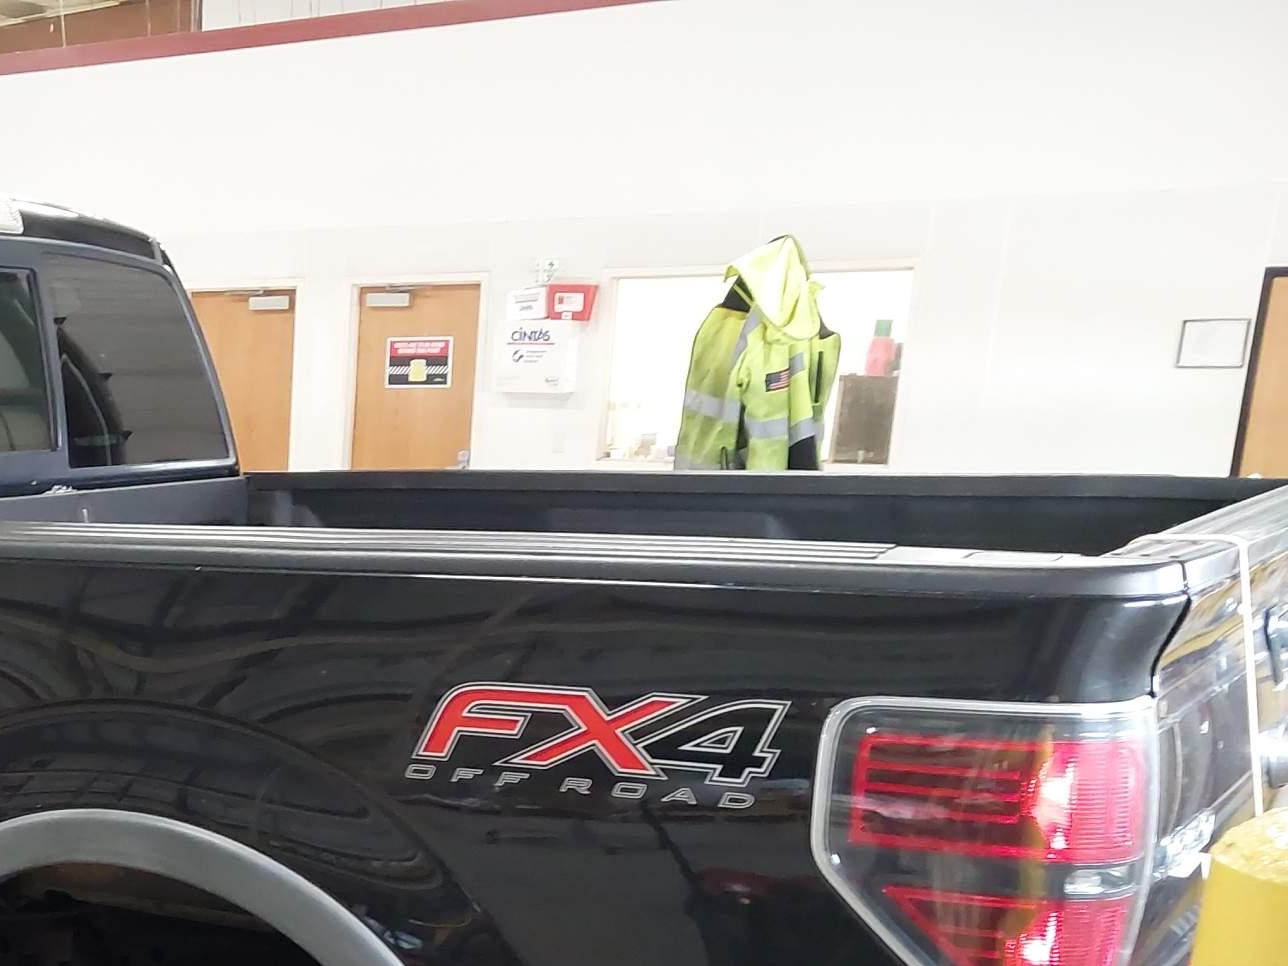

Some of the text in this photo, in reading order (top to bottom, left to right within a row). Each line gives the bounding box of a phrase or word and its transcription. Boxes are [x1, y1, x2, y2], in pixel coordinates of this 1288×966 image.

[412, 681, 792, 788] FX4
[404, 763, 757, 809] OFF ROAD
